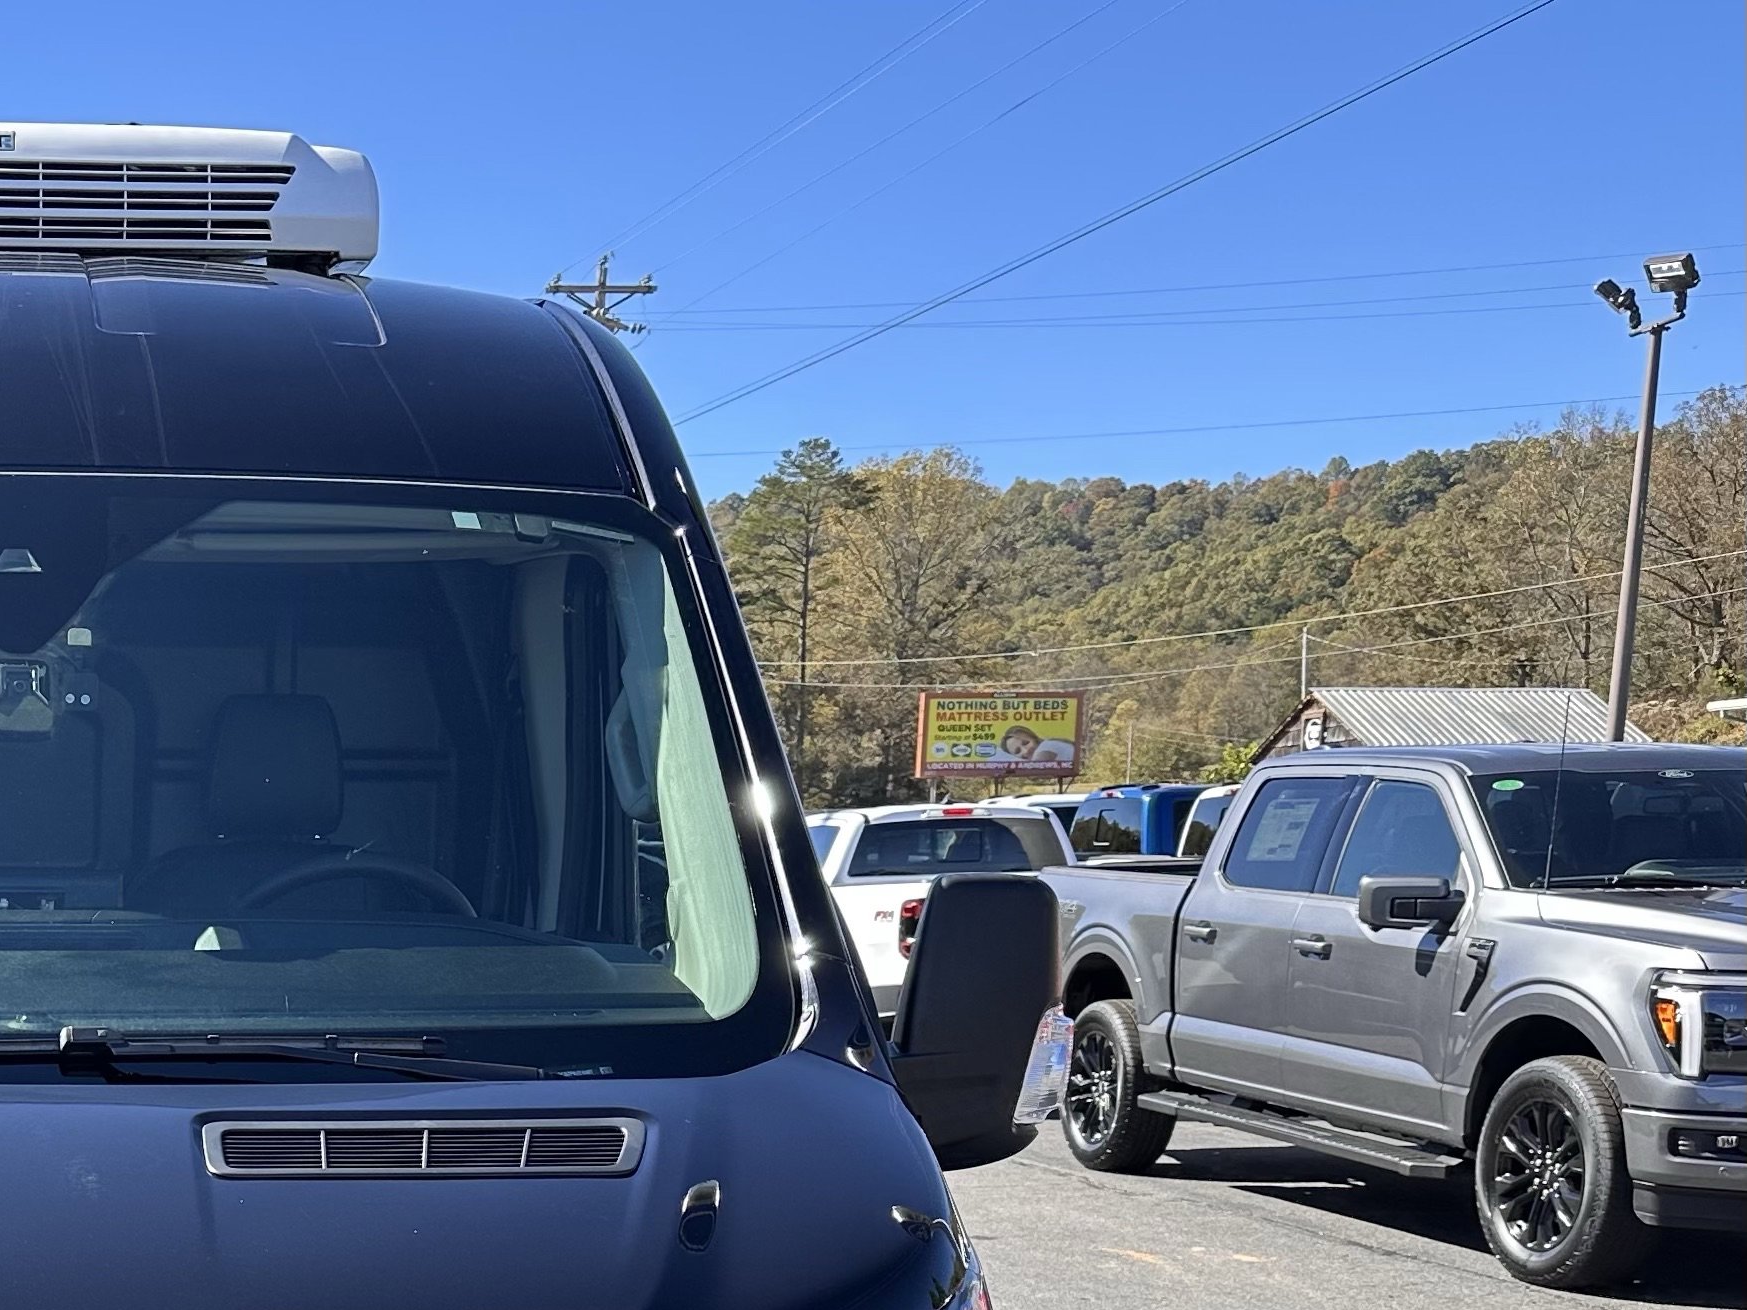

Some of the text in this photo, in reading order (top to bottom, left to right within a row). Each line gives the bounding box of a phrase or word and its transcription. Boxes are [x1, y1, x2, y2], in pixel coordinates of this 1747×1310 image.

[936, 700, 1069, 711] NOTHING BUT BEDS
[936, 711, 1067, 722] MATTRESS OUTLET
[937, 723, 993, 732] QUEEN SET
[926, 762, 964, 770] LOCATED
[965, 762, 975, 770] IN
[975, 762, 1009, 770] MURPHY
[1061, 761, 1073, 769] NC
